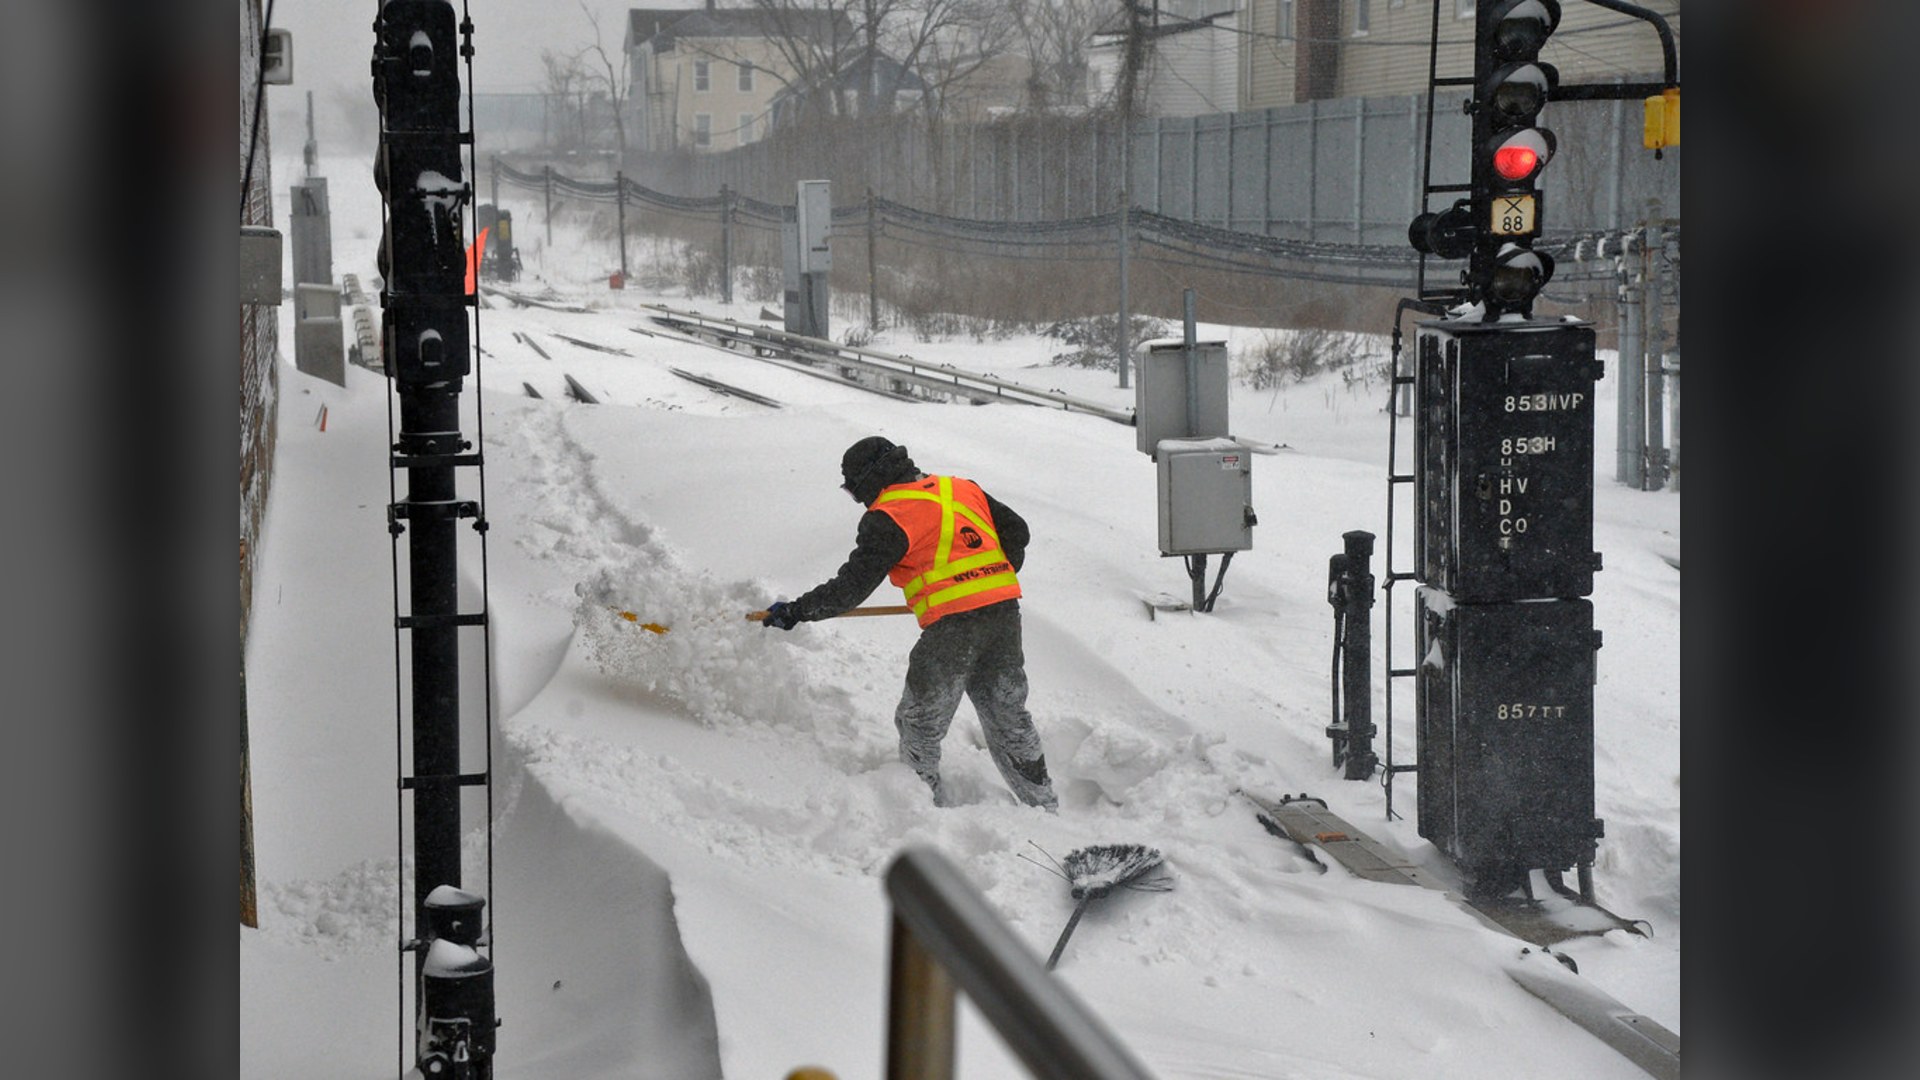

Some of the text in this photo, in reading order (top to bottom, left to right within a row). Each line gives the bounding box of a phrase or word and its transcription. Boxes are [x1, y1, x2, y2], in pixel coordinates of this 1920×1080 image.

[1502, 216, 1523, 232] 88
[1501, 437, 1555, 455] 853H
[1500, 499, 1512, 516] D
